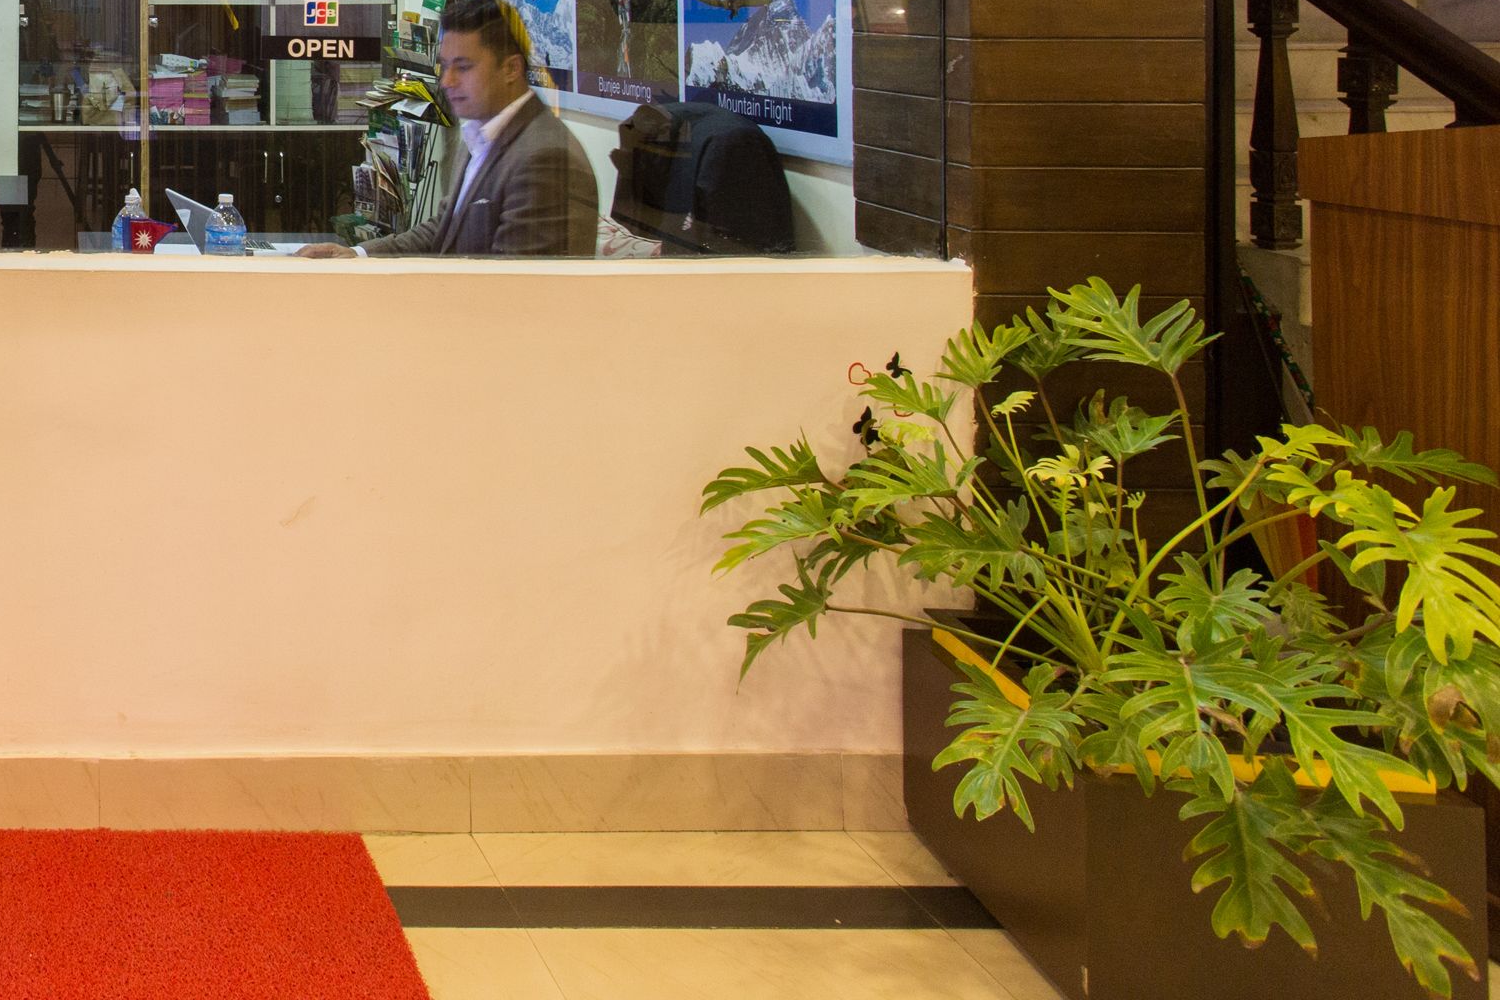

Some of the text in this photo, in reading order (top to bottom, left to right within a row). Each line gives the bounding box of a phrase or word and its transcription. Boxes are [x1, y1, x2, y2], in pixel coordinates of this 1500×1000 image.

[287, 39, 354, 58] OPEN
[599, 77, 652, 102] Bunjee Jumping
[718, 92, 792, 124] Mountain Flight
